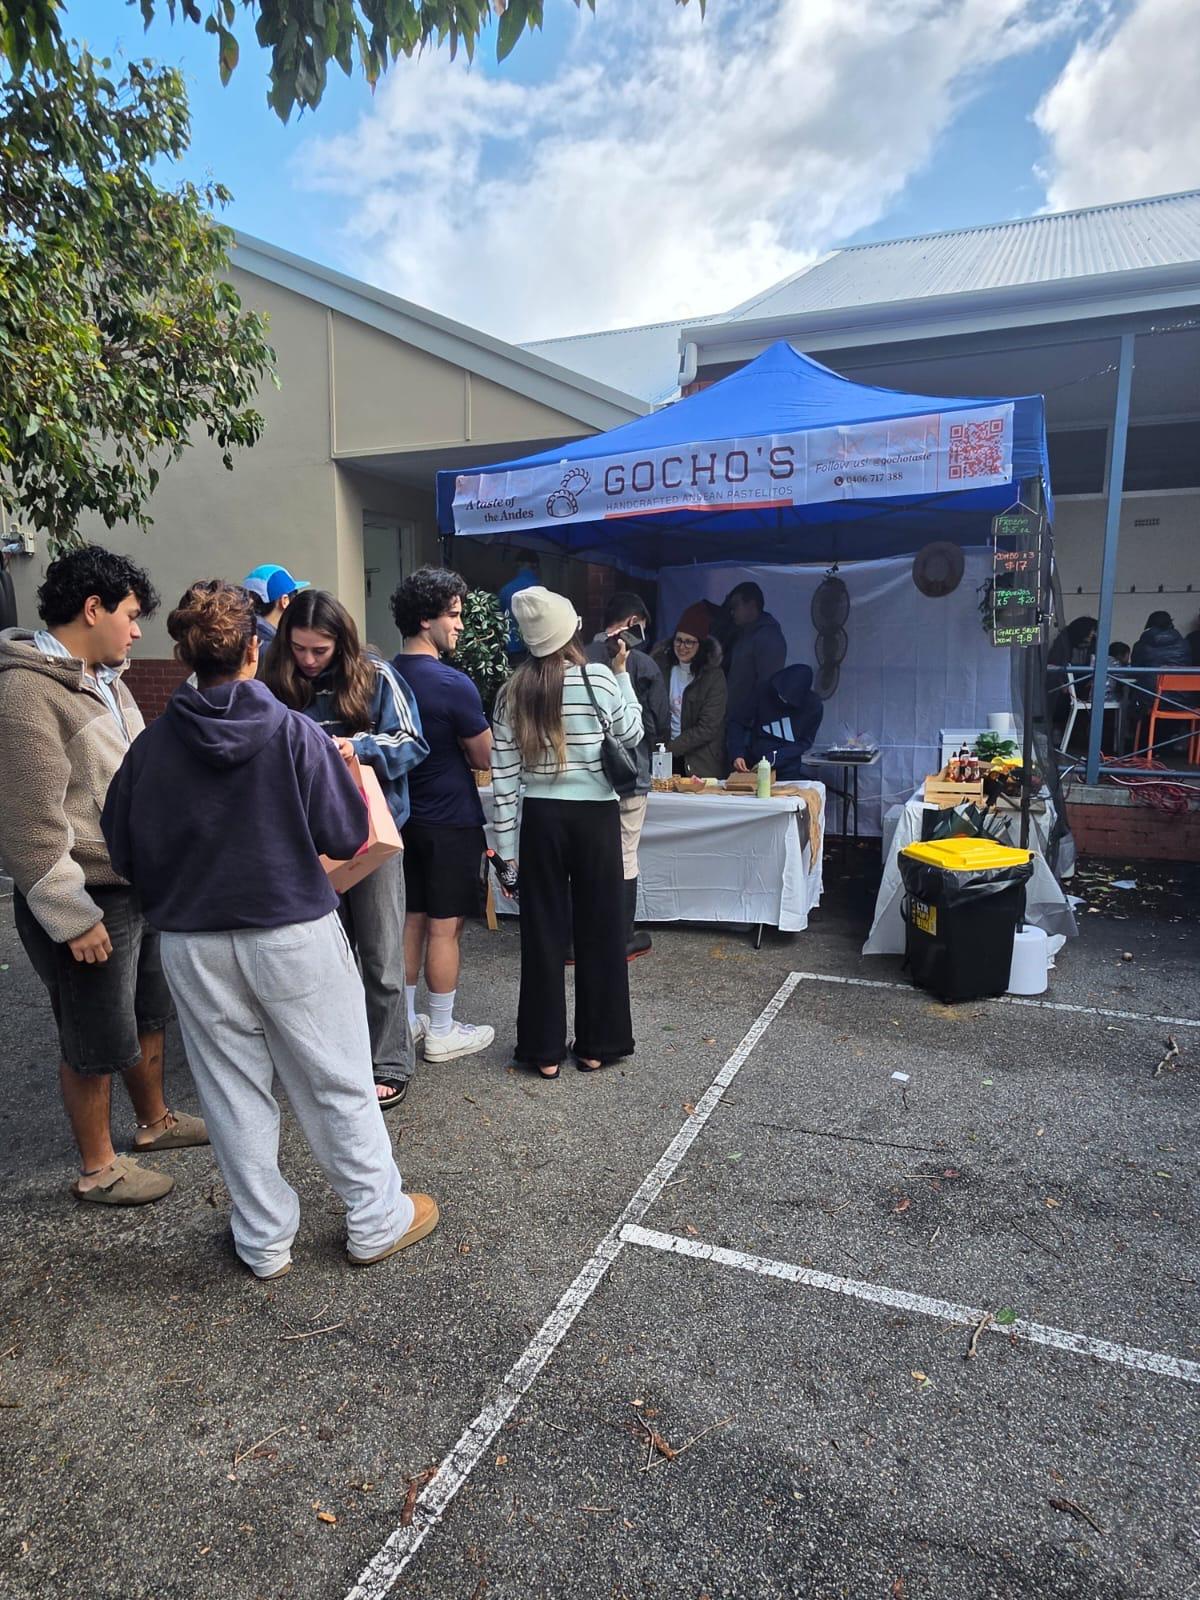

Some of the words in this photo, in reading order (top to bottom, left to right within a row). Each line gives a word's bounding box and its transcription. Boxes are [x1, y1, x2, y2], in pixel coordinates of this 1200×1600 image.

[604, 446, 795, 496] GOCHO'S
[815, 460, 850, 474] Follow
[846, 475, 869, 484] 0406
[871, 473, 885, 483] 717
[465, 500, 474, 511] A
[476, 498, 504, 510] taste
[505, 496, 517, 508] of
[606, 495, 679, 511] HANDCRAFTED
[682, 490, 723, 502] ANDEAN
[728, 486, 793, 498] PASTELITOS
[484, 513, 498, 523] the
[500, 508, 534, 521] Andes
[1004, 560, 1028, 571] $17
